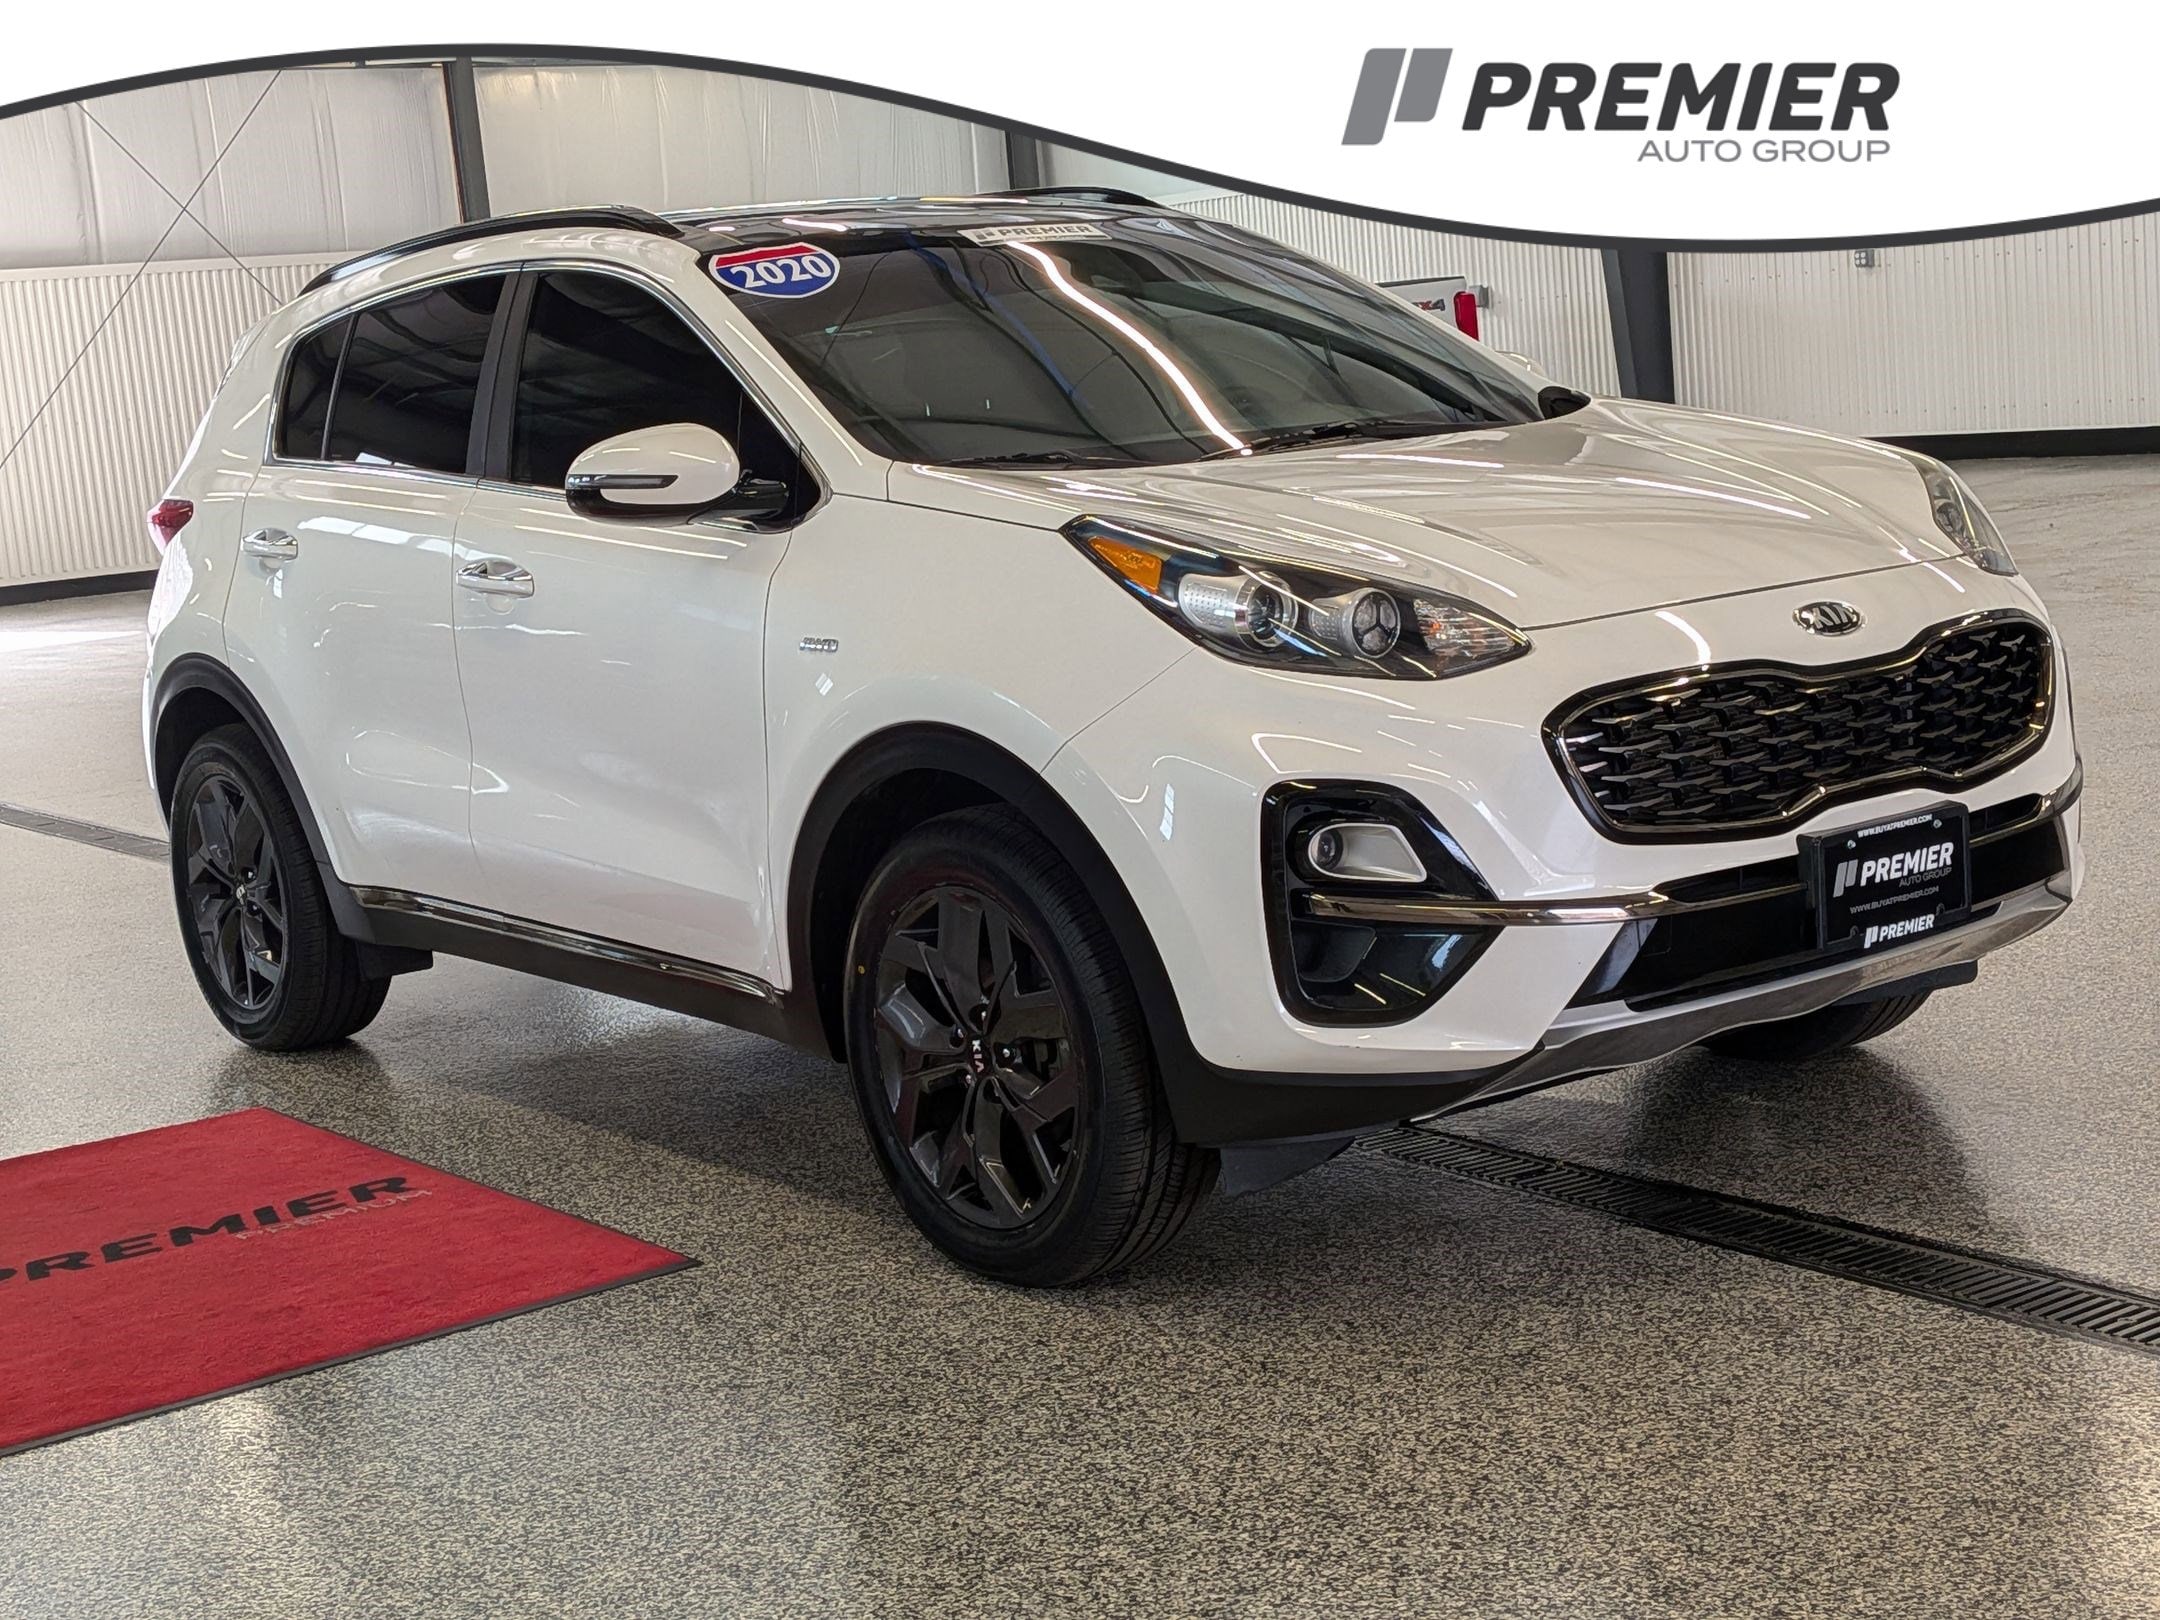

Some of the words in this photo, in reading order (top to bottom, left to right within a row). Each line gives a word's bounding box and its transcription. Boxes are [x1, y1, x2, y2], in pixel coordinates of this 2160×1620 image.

[998, 225, 1092, 237] PREMIER
[729, 252, 833, 289] 2020
[1860, 842, 1954, 887] PREMIER
[1899, 874, 1921, 887] AUTO
[1922, 867, 1952, 881] GROUP
[1879, 913, 1935, 942] PREMIER
